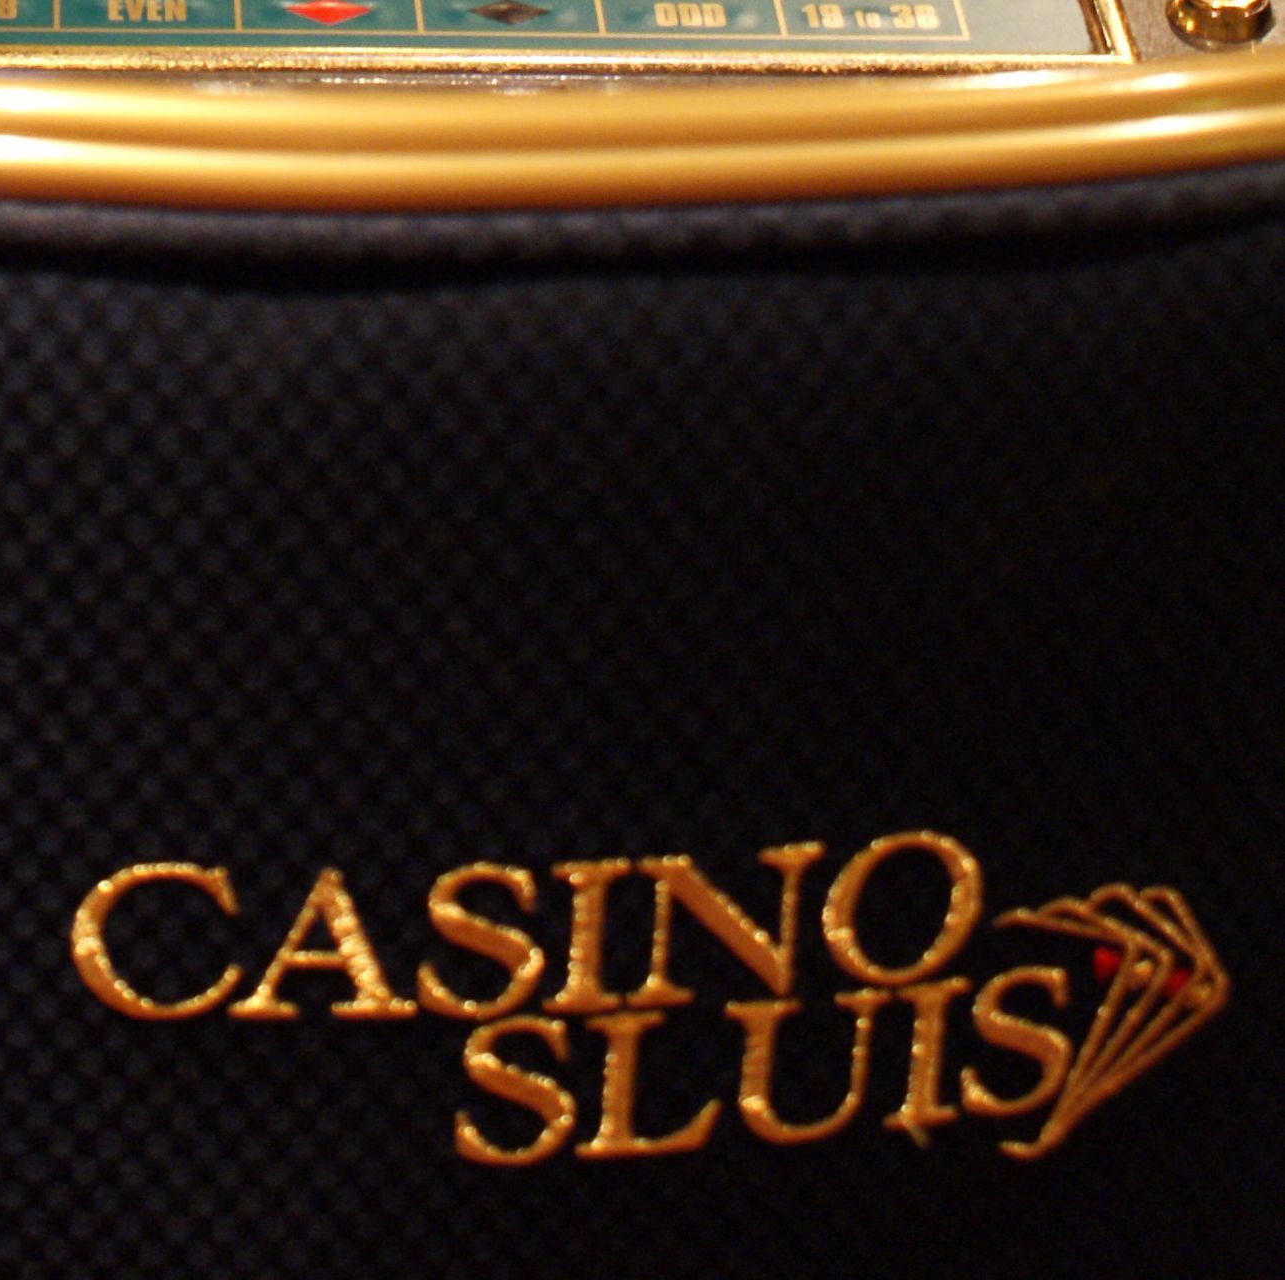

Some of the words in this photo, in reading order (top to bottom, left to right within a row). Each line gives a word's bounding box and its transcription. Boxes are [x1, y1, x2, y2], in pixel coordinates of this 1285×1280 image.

[653, 2, 727, 28] ODD
[802, 4, 845, 29] 19
[854, 9, 882, 29] to
[889, 3, 939, 29] 36
[72, 829, 982, 1019] CASINO
[451, 965, 1070, 1165] SLUIS
